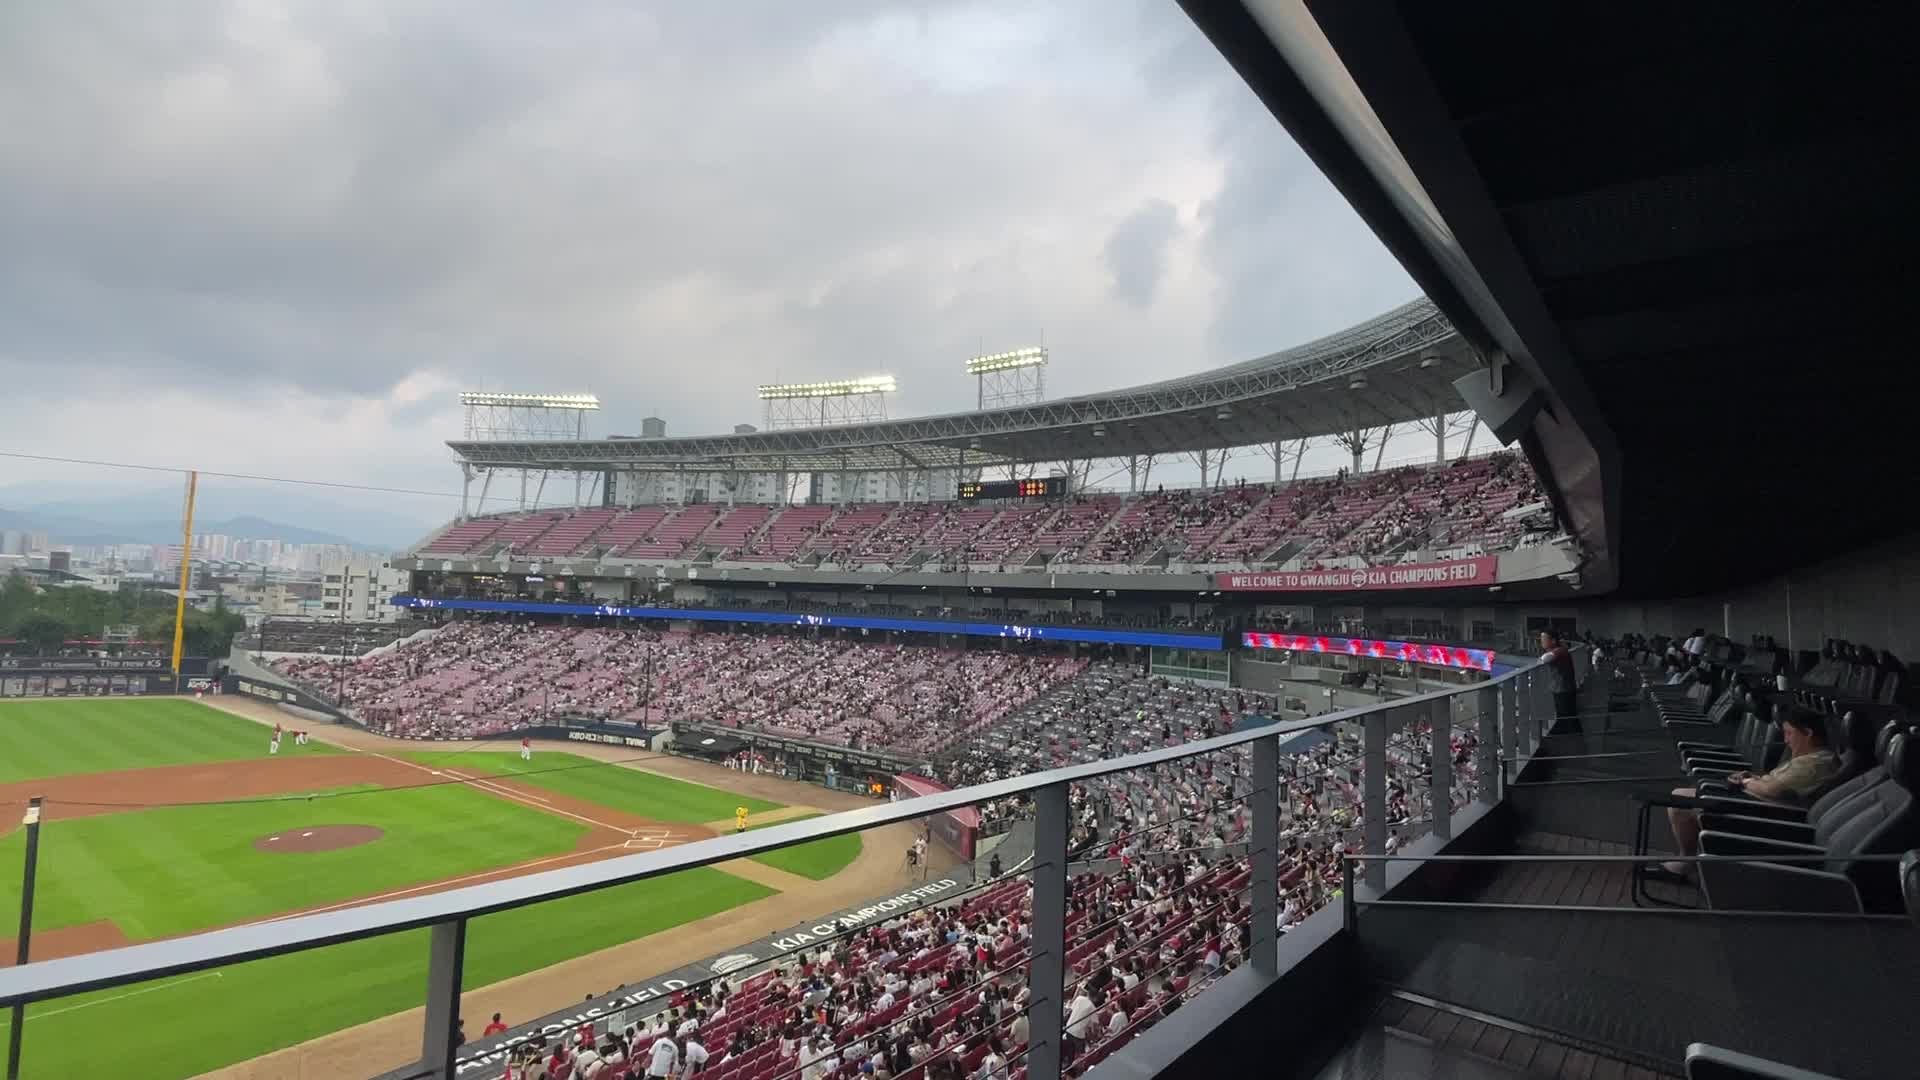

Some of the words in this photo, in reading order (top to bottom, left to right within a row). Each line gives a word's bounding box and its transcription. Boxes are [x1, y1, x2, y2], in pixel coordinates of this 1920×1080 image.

[1231, 575, 1283, 588] WELCOME
[1286, 575, 1298, 586] TO
[1300, 573, 1349, 586] GWANGJU
[1368, 571, 1387, 585] KIA
[1390, 566, 1447, 584] CHAMPIONS
[1450, 563, 1476, 580] FIELD
[772, 932, 815, 951] KIA
[912, 878, 957, 898] FIELD
